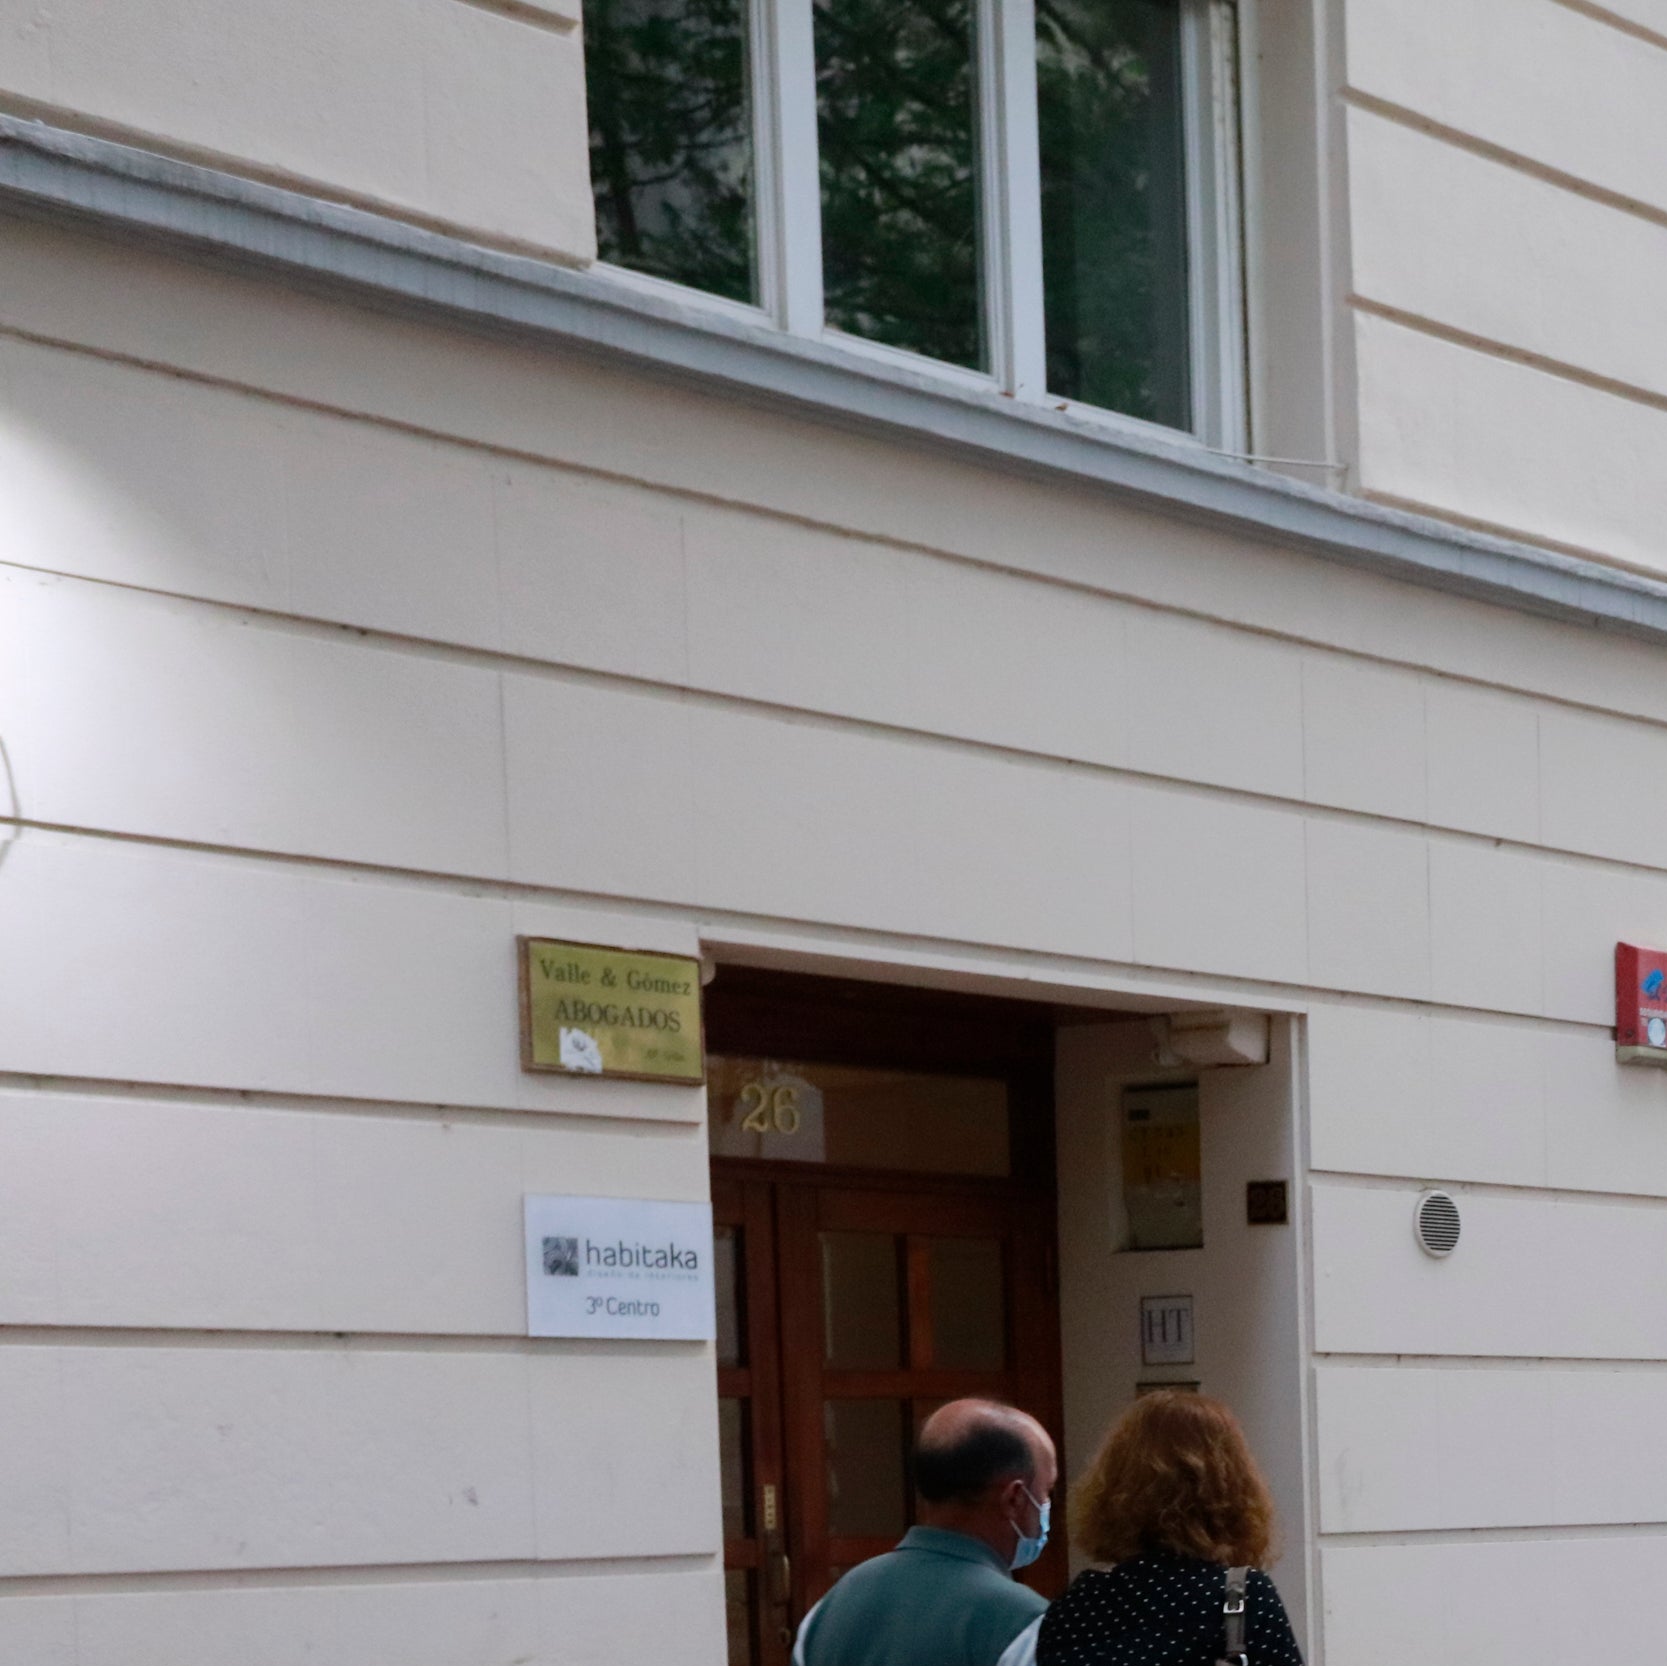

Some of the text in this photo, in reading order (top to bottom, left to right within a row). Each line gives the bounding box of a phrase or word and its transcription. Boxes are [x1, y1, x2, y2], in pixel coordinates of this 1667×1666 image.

[539, 958, 692, 996] Valle & Gómez
[554, 1000, 682, 1033] ABOGADOS
[741, 1081, 800, 1134] 26
[586, 1239, 698, 1270] habitaka
[606, 1297, 660, 1317] Centro
